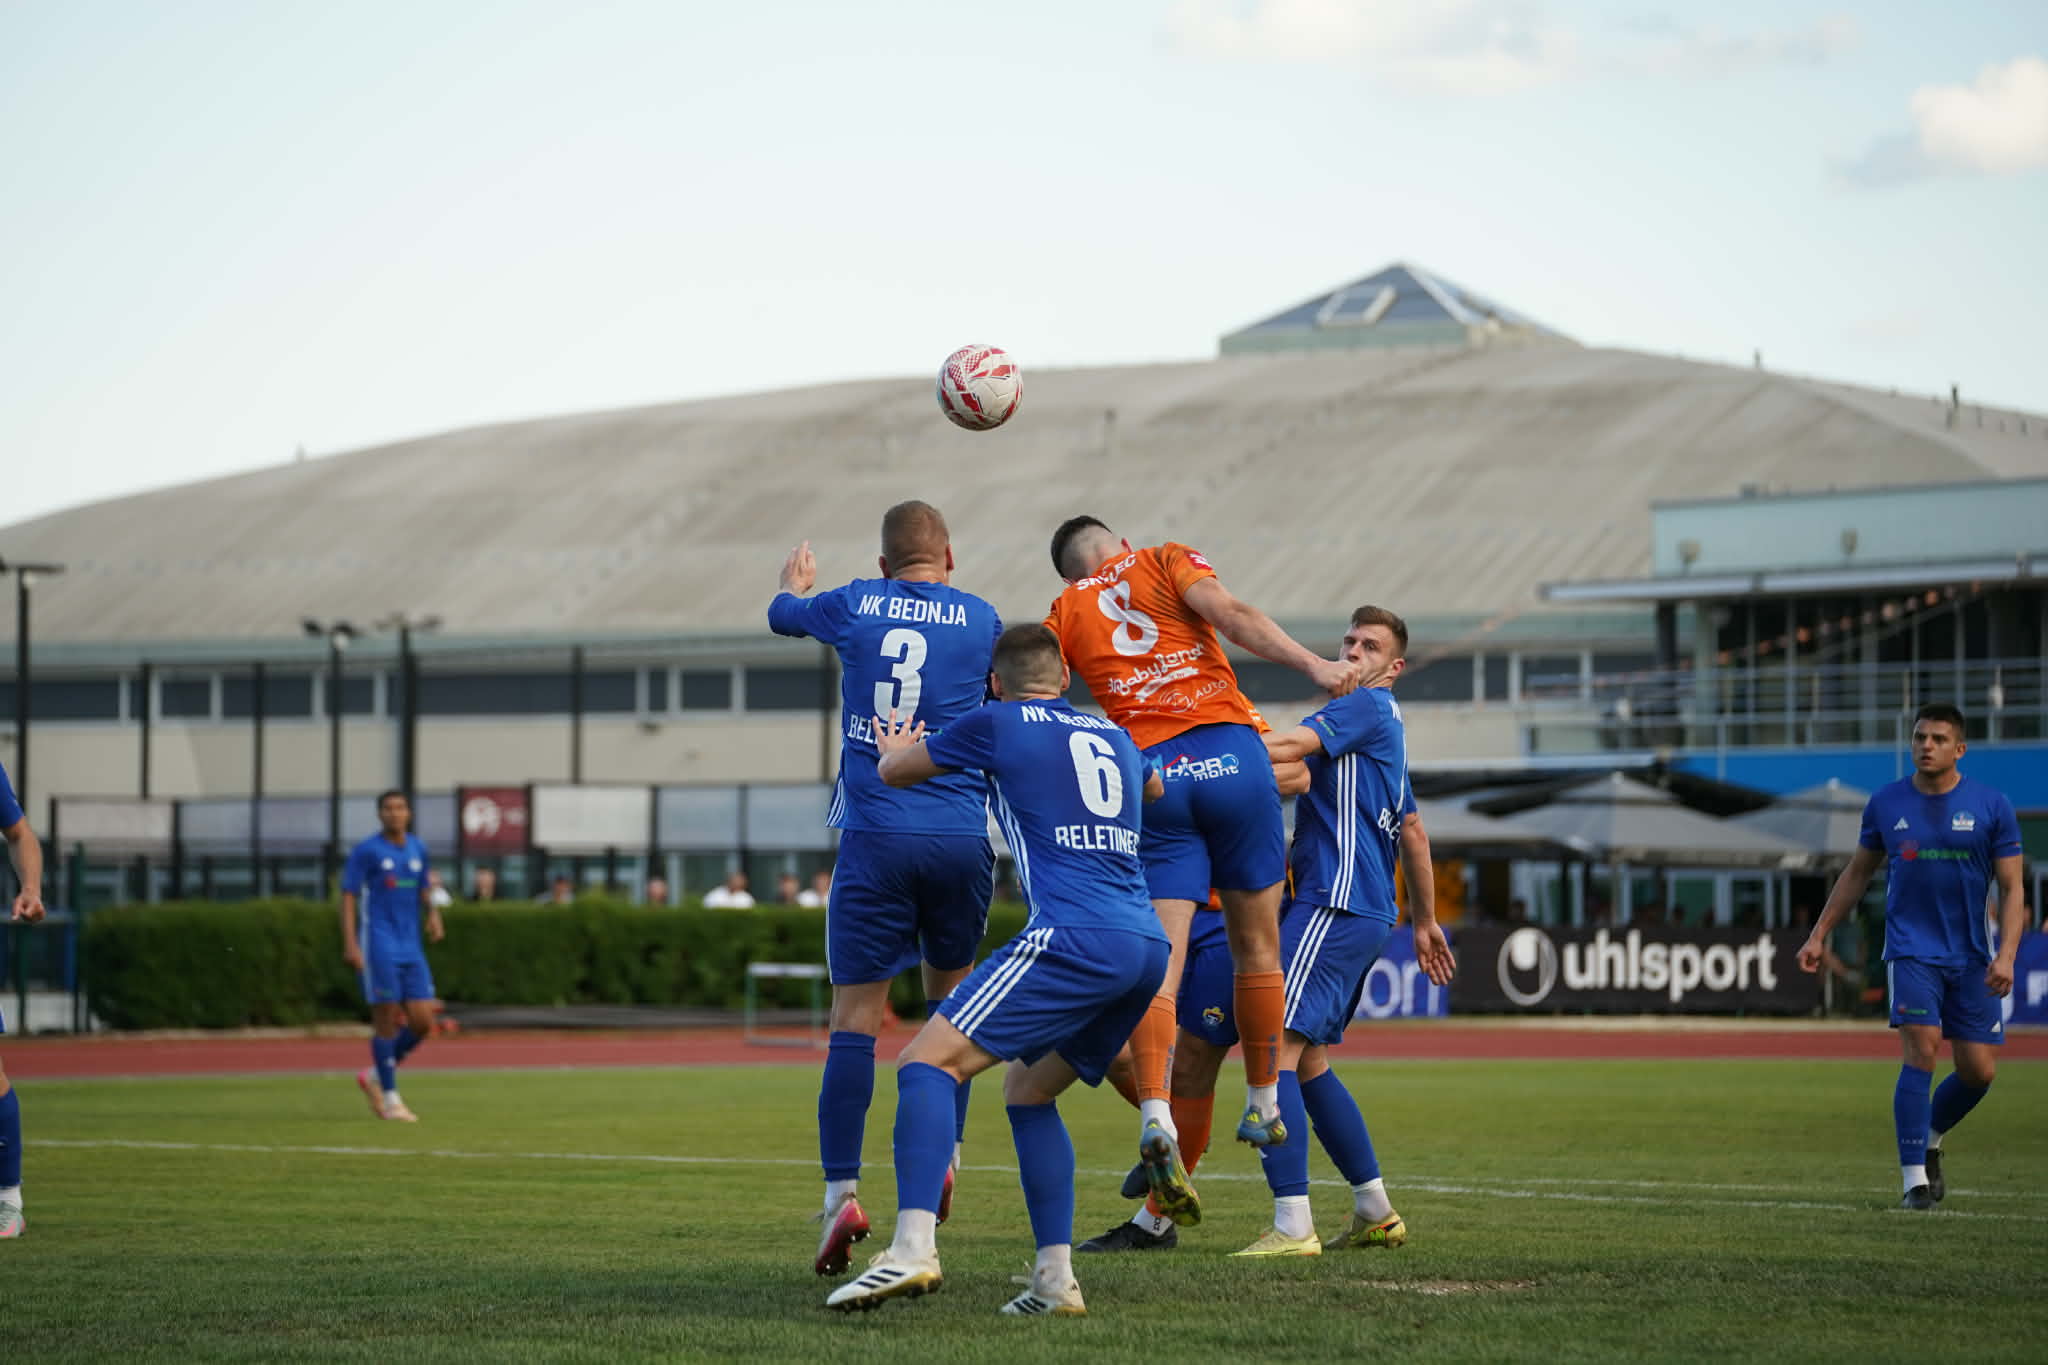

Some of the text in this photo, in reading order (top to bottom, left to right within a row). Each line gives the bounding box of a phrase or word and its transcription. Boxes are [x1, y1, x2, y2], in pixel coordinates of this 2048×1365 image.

[857, 594, 967, 627] NK BEDNJA
[1098, 580, 1160, 656] 8
[874, 628, 928, 723] 3
[1021, 705, 1053, 722] NK
[1069, 731, 1123, 819] 6
[1562, 928, 1777, 1003] uhlsport
